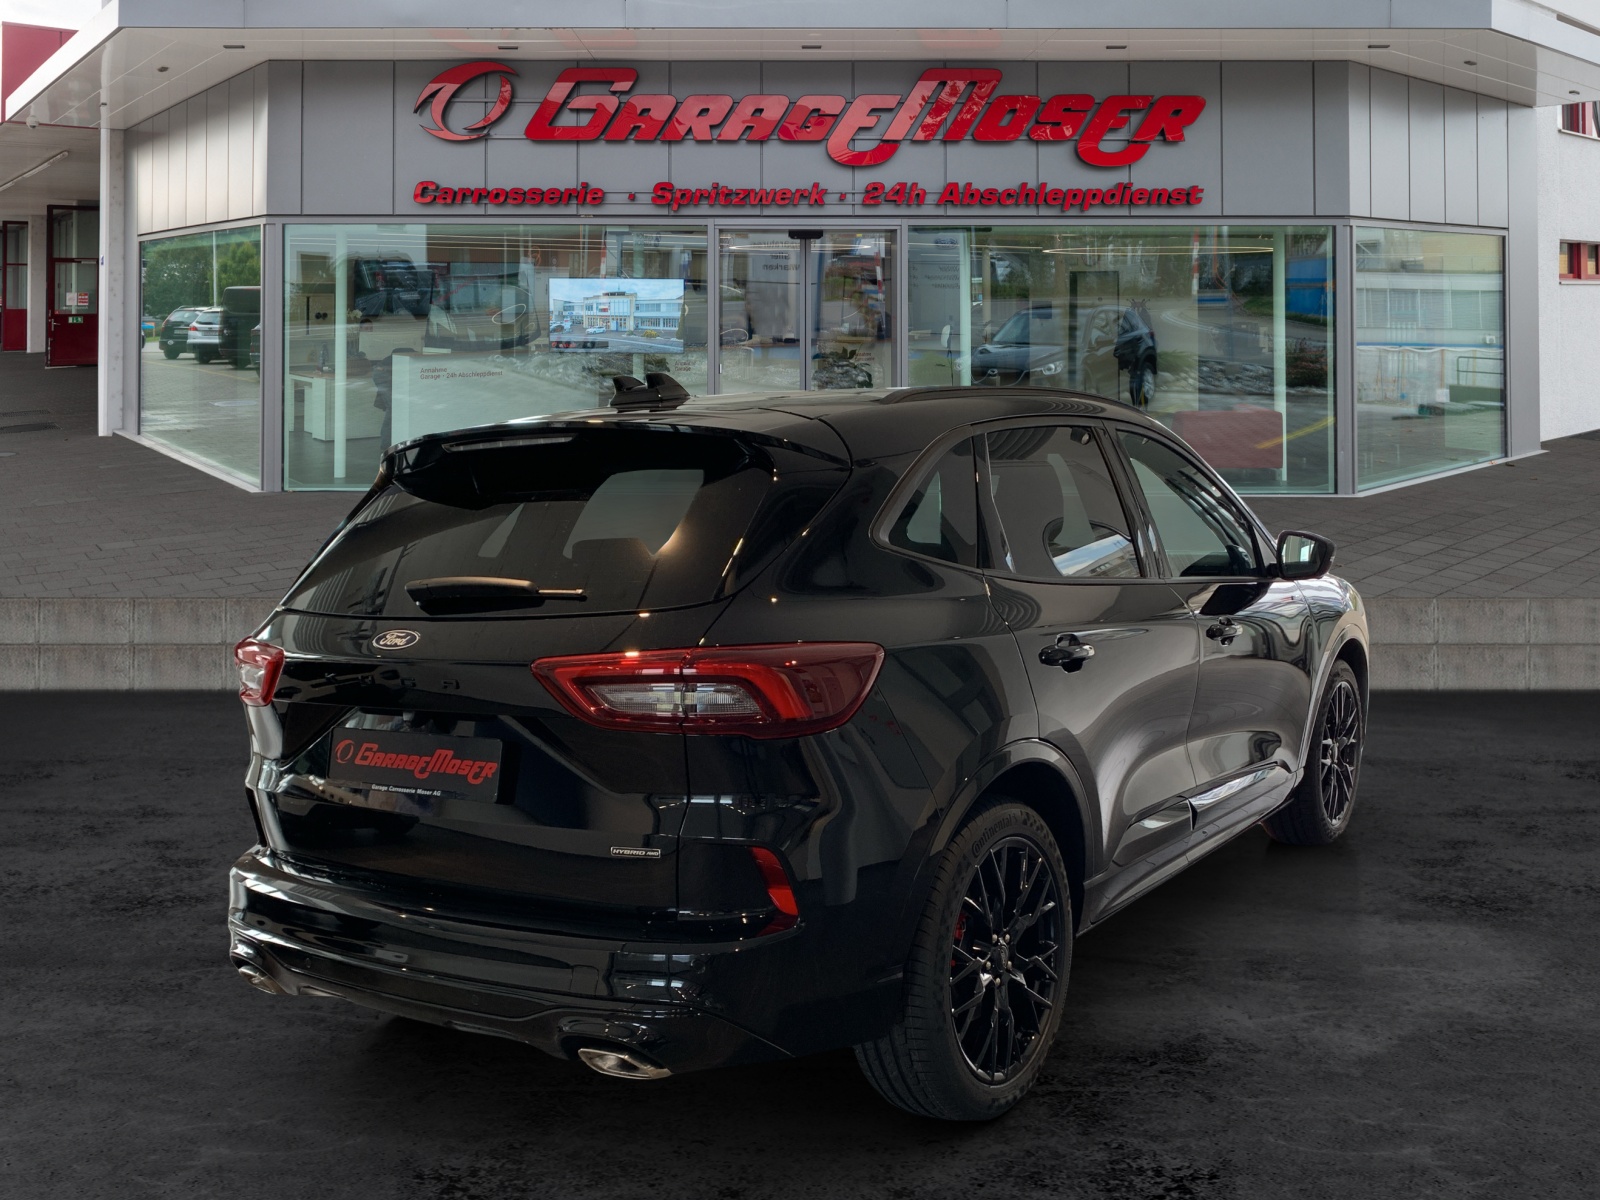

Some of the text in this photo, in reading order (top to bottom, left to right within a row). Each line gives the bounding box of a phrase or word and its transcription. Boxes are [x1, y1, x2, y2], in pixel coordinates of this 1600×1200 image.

[413, 181, 1204, 212] Carrosserie Spritzwerk 24h Abschleppdienst
[380, 632, 411, 646] Ford
[972, 814, 1013, 857] Continental
